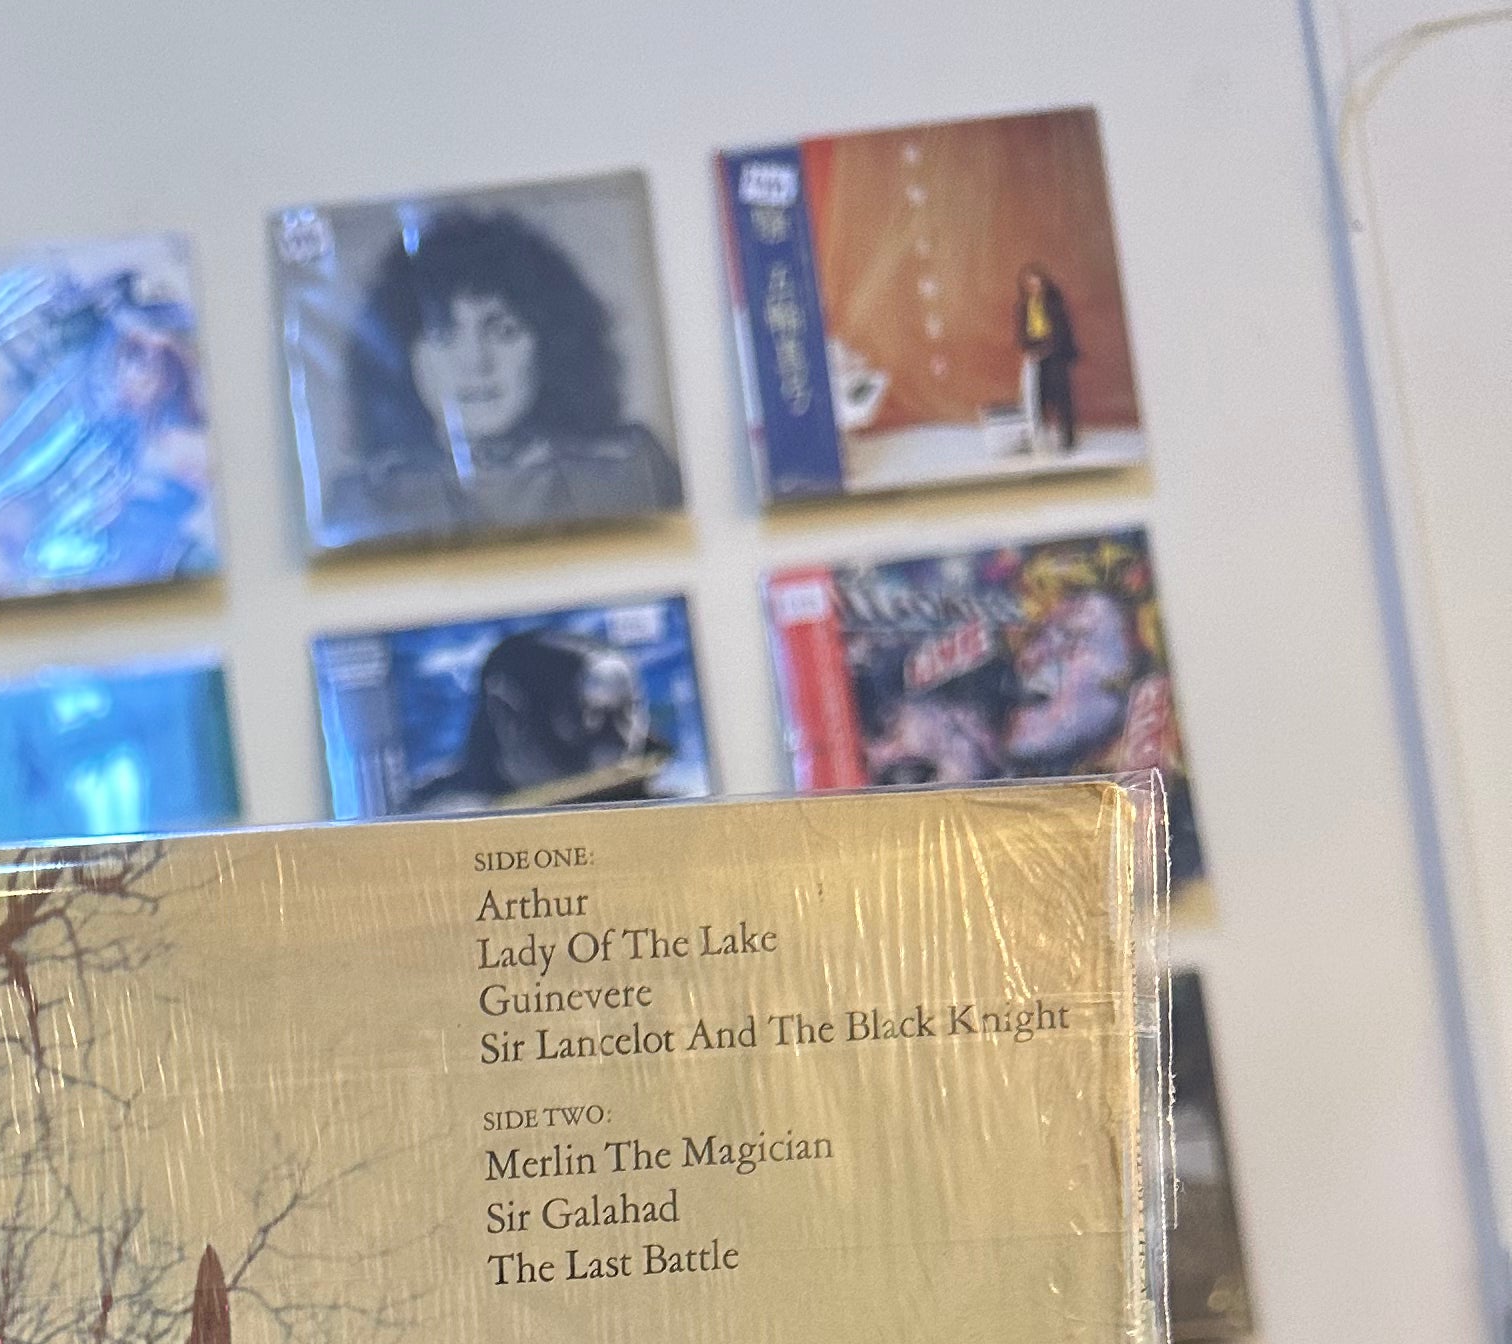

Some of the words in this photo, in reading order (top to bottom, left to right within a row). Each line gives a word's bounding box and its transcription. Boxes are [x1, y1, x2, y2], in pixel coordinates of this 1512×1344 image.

[474, 850, 530, 872] SIDE
[534, 847, 595, 868] ONE:
[476, 887, 589, 922] Arthur
[477, 933, 556, 977] Lady
[567, 928, 616, 964] Of
[621, 926, 689, 961] The
[699, 921, 778, 957] Lake
[478, 981, 654, 1017] Guinevere
[480, 1030, 526, 1065] Sir
[535, 1022, 676, 1061] Lancelot
[685, 1014, 758, 1051] And
[767, 1012, 836, 1047] The
[845, 1004, 937, 1043] Black
[946, 999, 1071, 1044] Knight
[482, 1109, 539, 1132] SIDE
[542, 1104, 613, 1128] TWO:
[484, 1143, 598, 1182] Merlin
[603, 1138, 672, 1174] The
[680, 1129, 834, 1176] Magician
[486, 1200, 532, 1234] Sir
[541, 1188, 681, 1231] Galahad
[487, 1251, 556, 1287] The
[565, 1248, 633, 1282] Last
[641, 1238, 740, 1276] Battle
